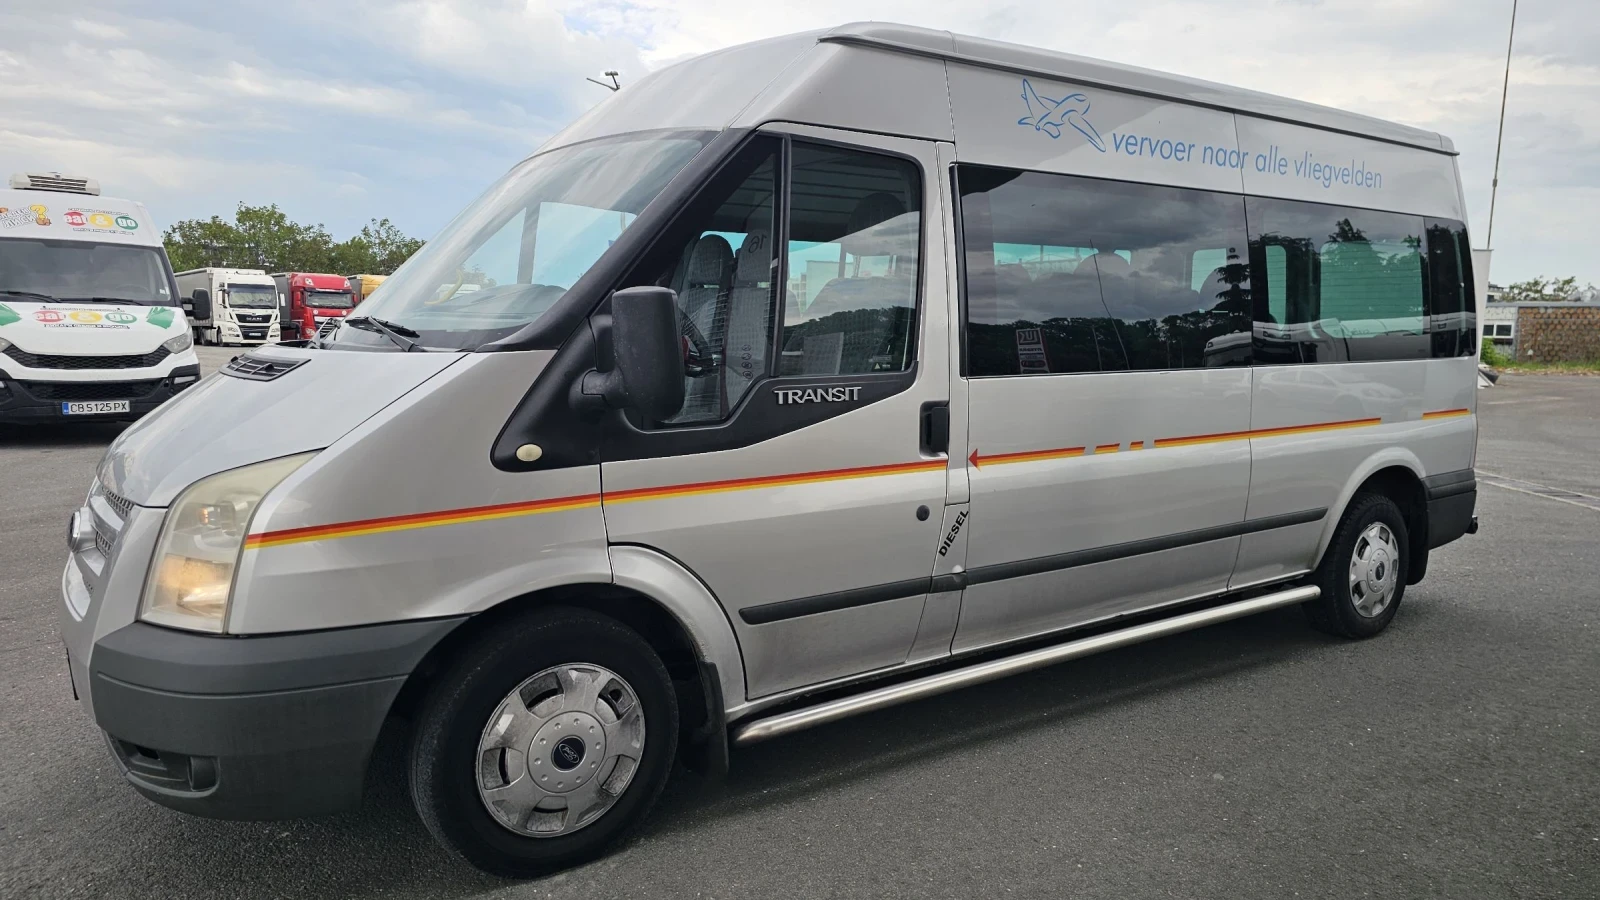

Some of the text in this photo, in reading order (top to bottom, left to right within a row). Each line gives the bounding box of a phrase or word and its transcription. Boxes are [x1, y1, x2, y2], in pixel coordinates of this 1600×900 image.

[1112, 132, 1382, 188] vervoer naar alle vliegvelden
[64, 214, 88, 224] eat
[117, 218, 136, 227] go
[773, 386, 862, 405] TRANSIT
[938, 510, 969, 557] DIESEL
